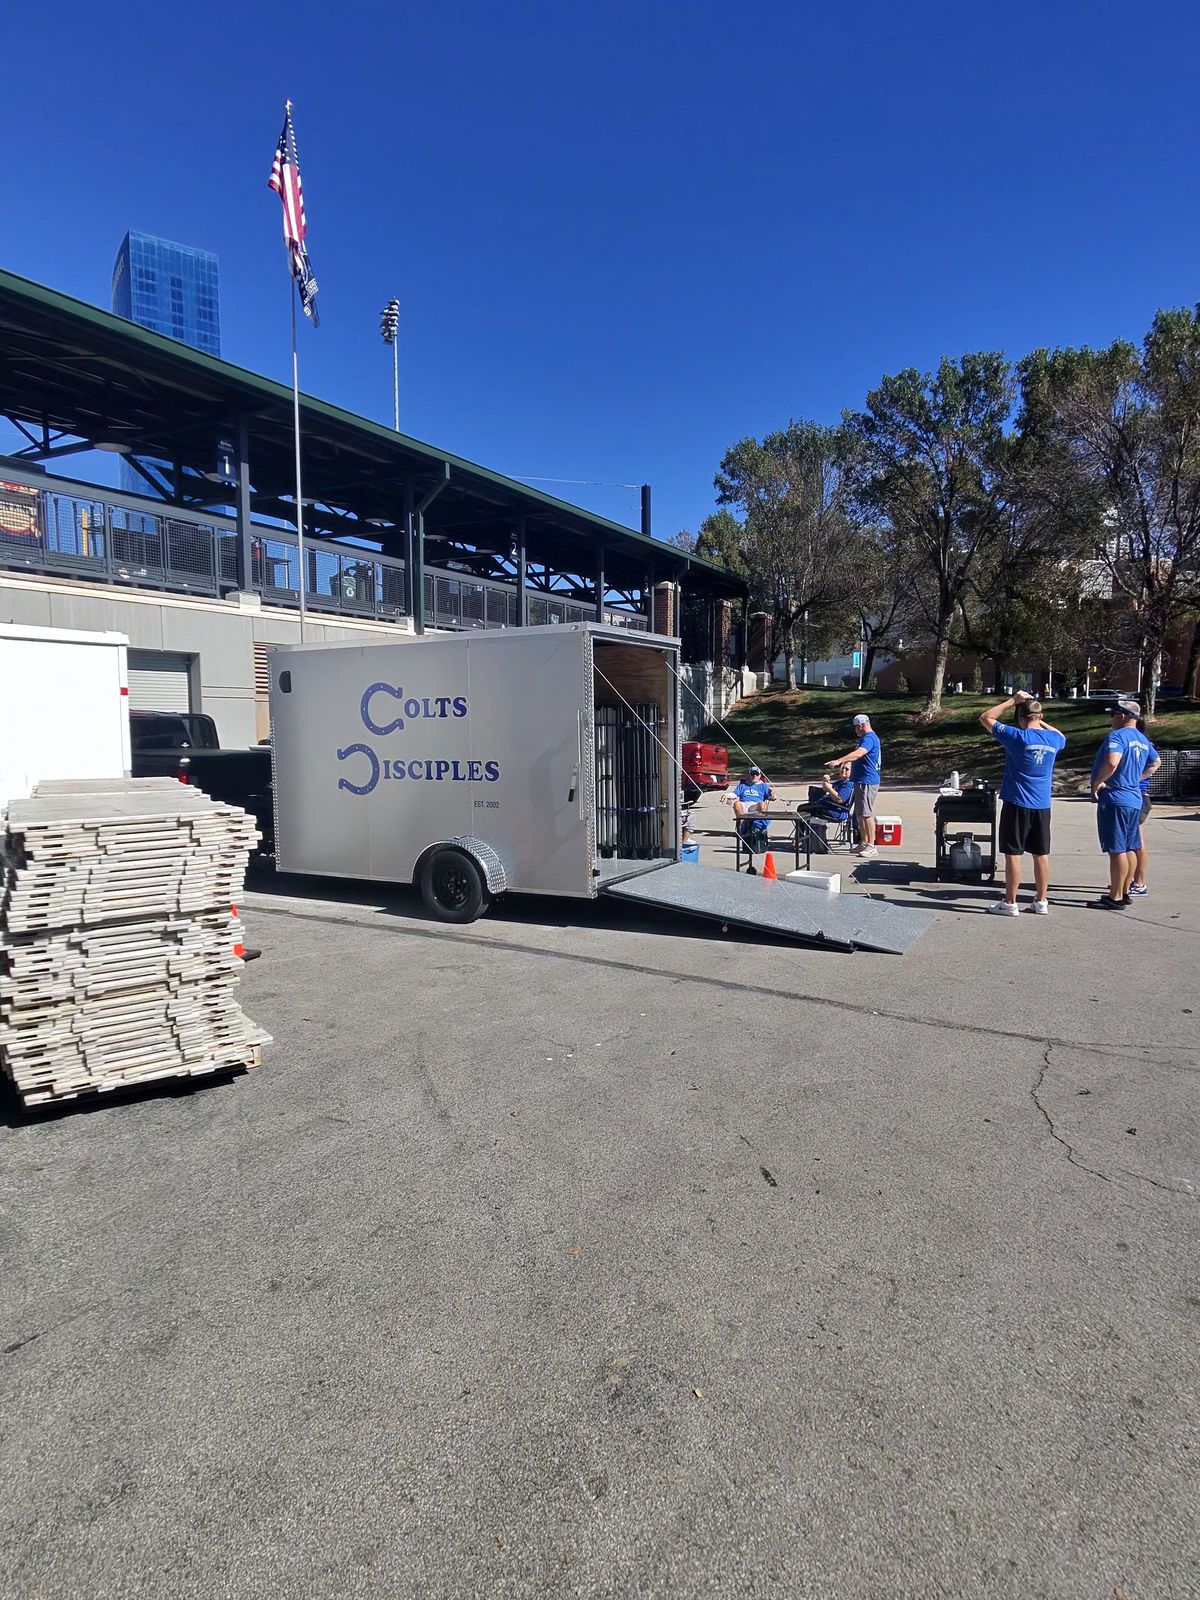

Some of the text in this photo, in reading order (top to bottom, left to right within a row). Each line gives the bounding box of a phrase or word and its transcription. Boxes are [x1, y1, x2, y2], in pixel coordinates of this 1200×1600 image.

[223, 455, 230, 474] 1
[511, 542, 518, 555] 2
[361, 682, 468, 736] COLTS
[485, 801, 500, 809] 2002
